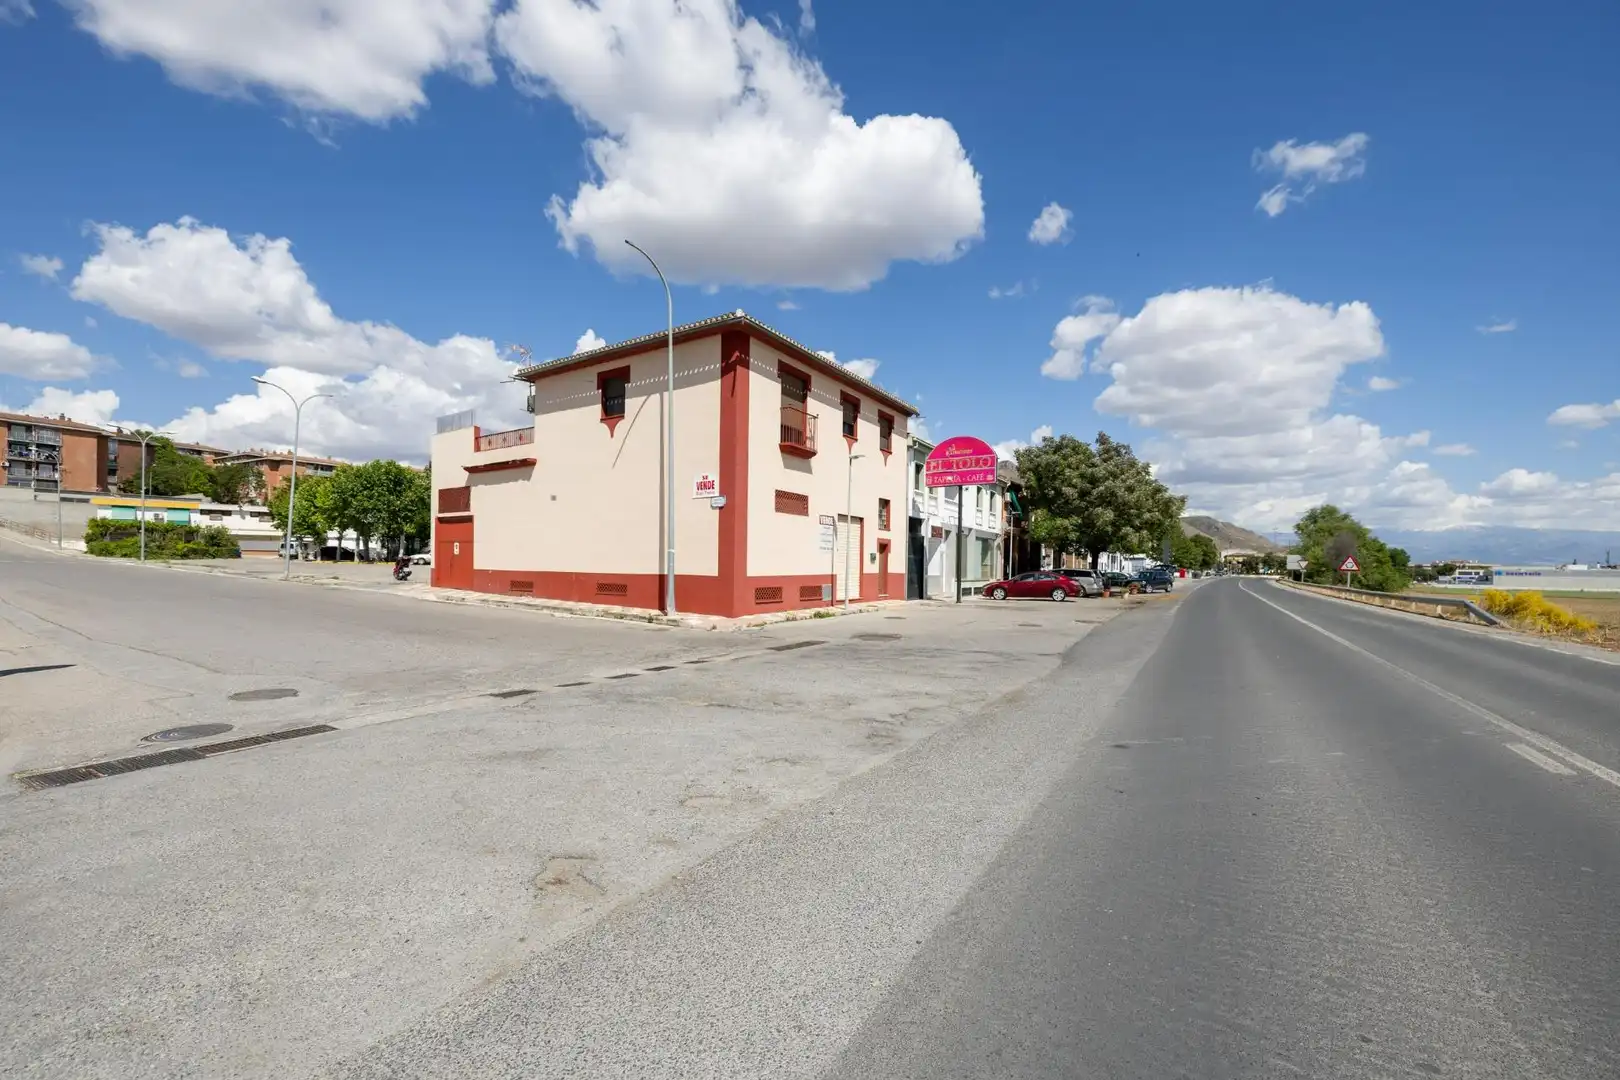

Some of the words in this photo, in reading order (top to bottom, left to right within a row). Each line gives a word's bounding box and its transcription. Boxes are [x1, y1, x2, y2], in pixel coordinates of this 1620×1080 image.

[929, 460, 945, 471] EL
[950, 456, 992, 470] TOLO
[966, 473, 984, 482] CAFÉ
[696, 480, 715, 491] VENDE
